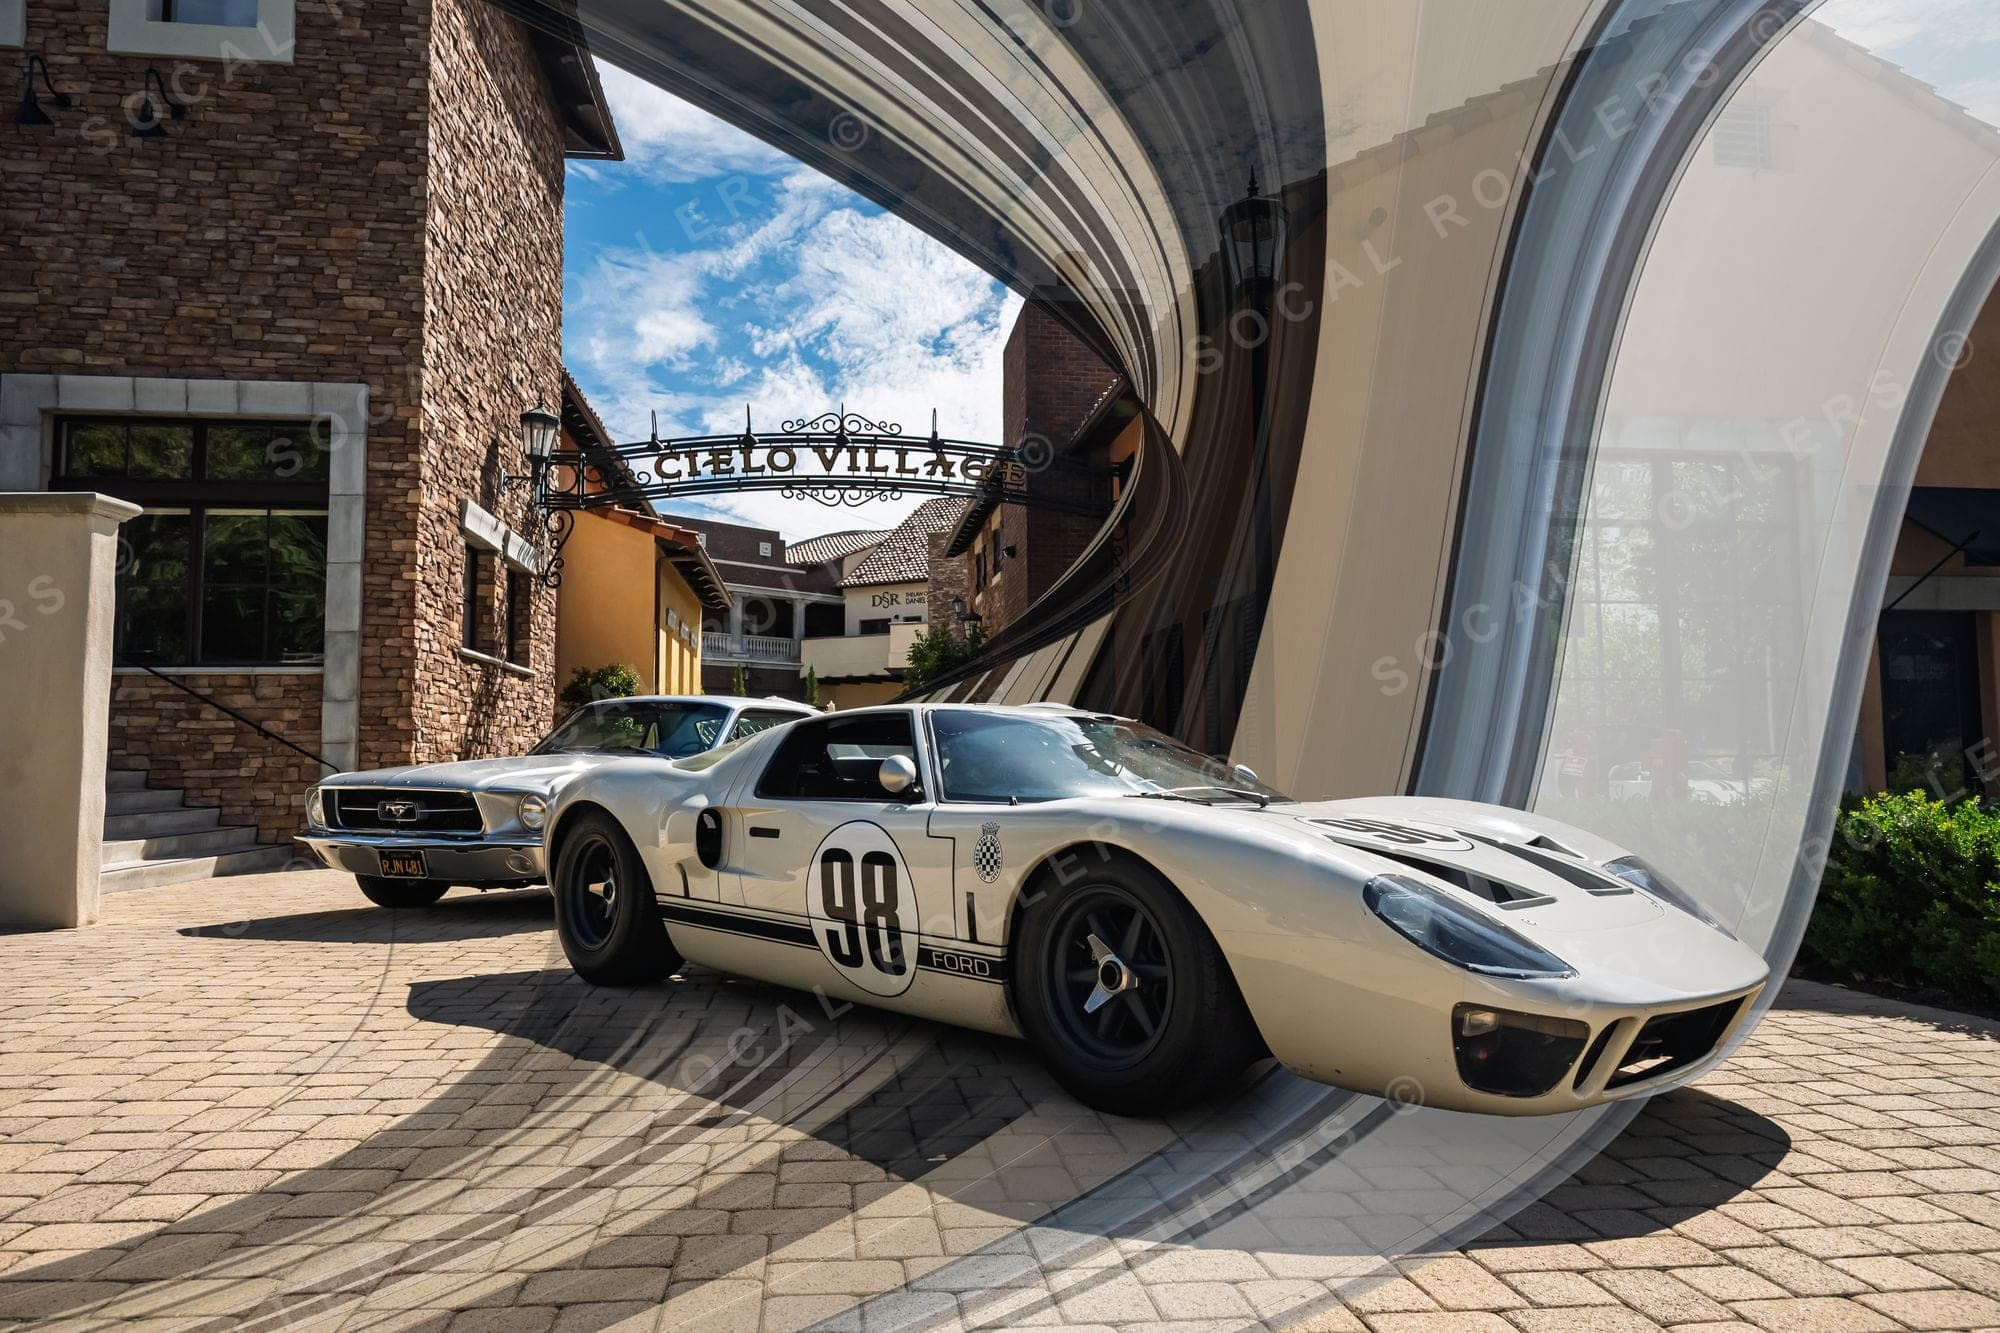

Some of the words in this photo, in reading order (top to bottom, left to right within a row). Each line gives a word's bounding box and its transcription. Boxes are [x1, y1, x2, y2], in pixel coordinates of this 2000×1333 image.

[654, 447, 797, 479] CIELO
[812, 447, 1026, 485] VILLAGE
[382, 859, 404, 874] RJN
[405, 860, 424, 875] 481
[820, 847, 907, 976] 98
[931, 951, 990, 976] FORD
